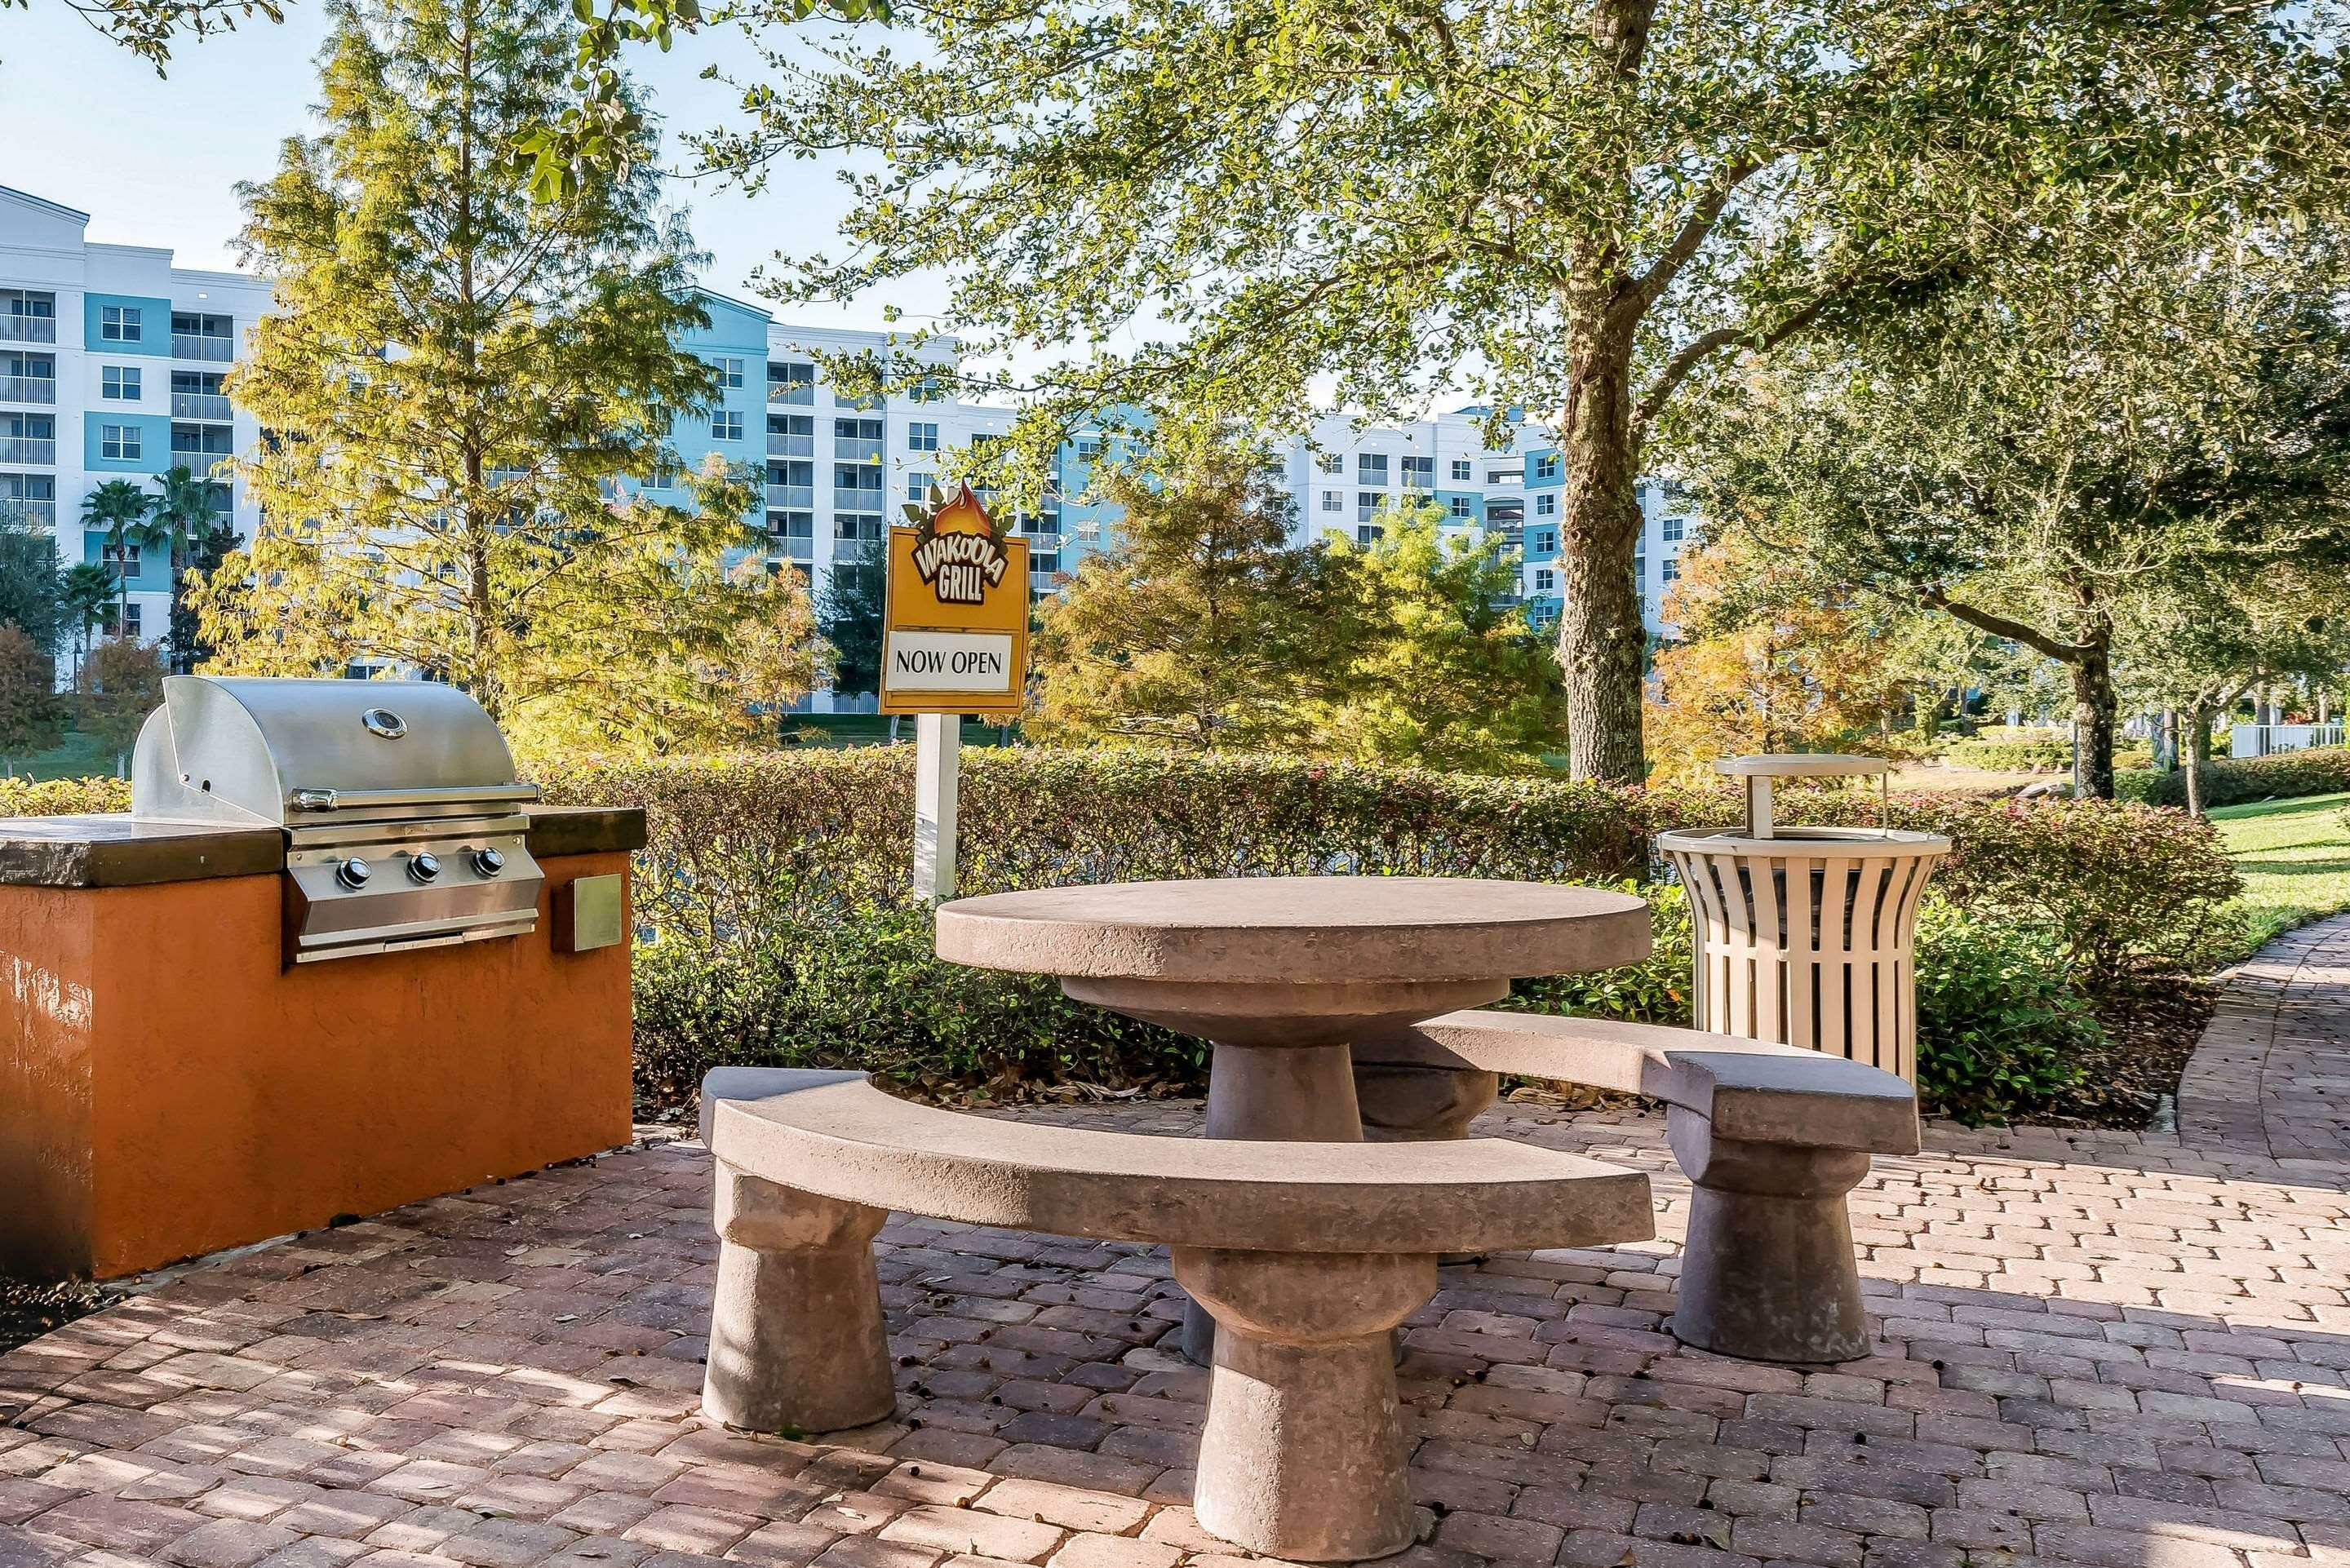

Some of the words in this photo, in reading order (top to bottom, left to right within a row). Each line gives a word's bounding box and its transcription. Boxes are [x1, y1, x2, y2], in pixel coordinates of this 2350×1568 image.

[916, 535, 1005, 582] WAKOOLA
[939, 565, 982, 600] GRILL
[896, 650, 947, 673] NOW
[951, 651, 1001, 674] OPEN
